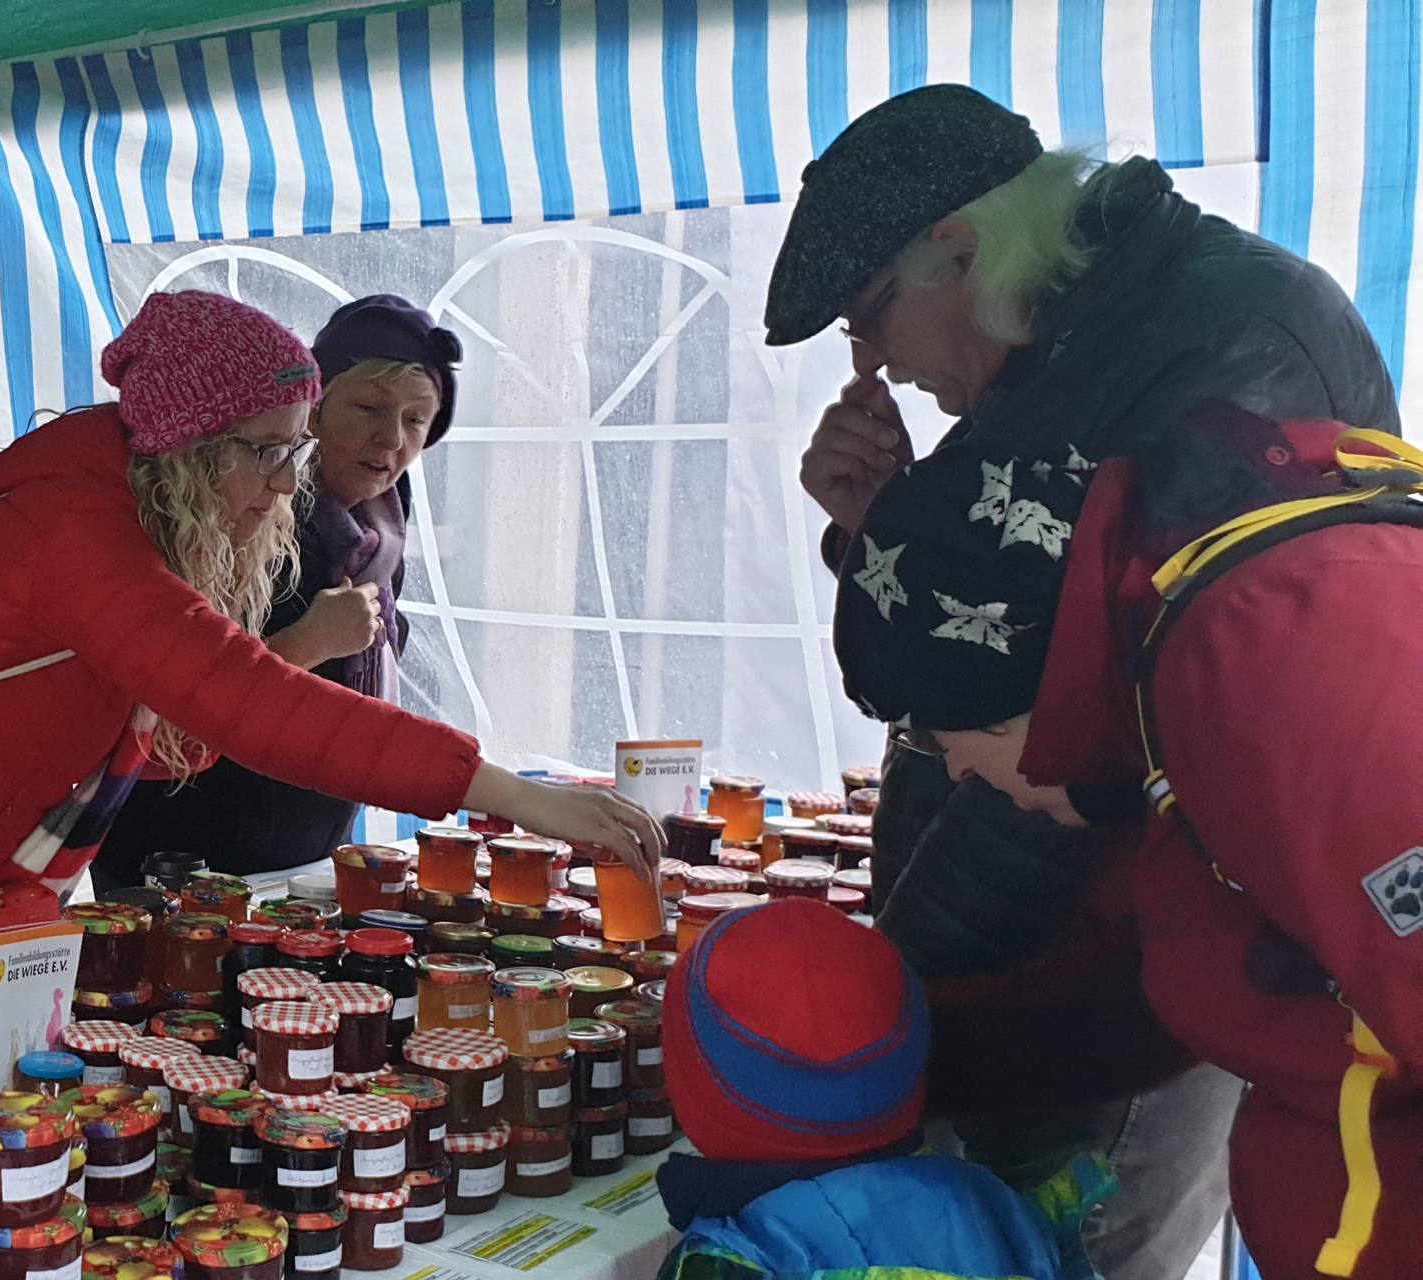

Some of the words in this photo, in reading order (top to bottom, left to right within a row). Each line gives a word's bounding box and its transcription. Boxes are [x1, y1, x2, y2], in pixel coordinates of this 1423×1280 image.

[7, 968, 20, 982] DIE
[22, 963, 49, 978] WIEGE
[51, 960, 68, 974] E.V.
